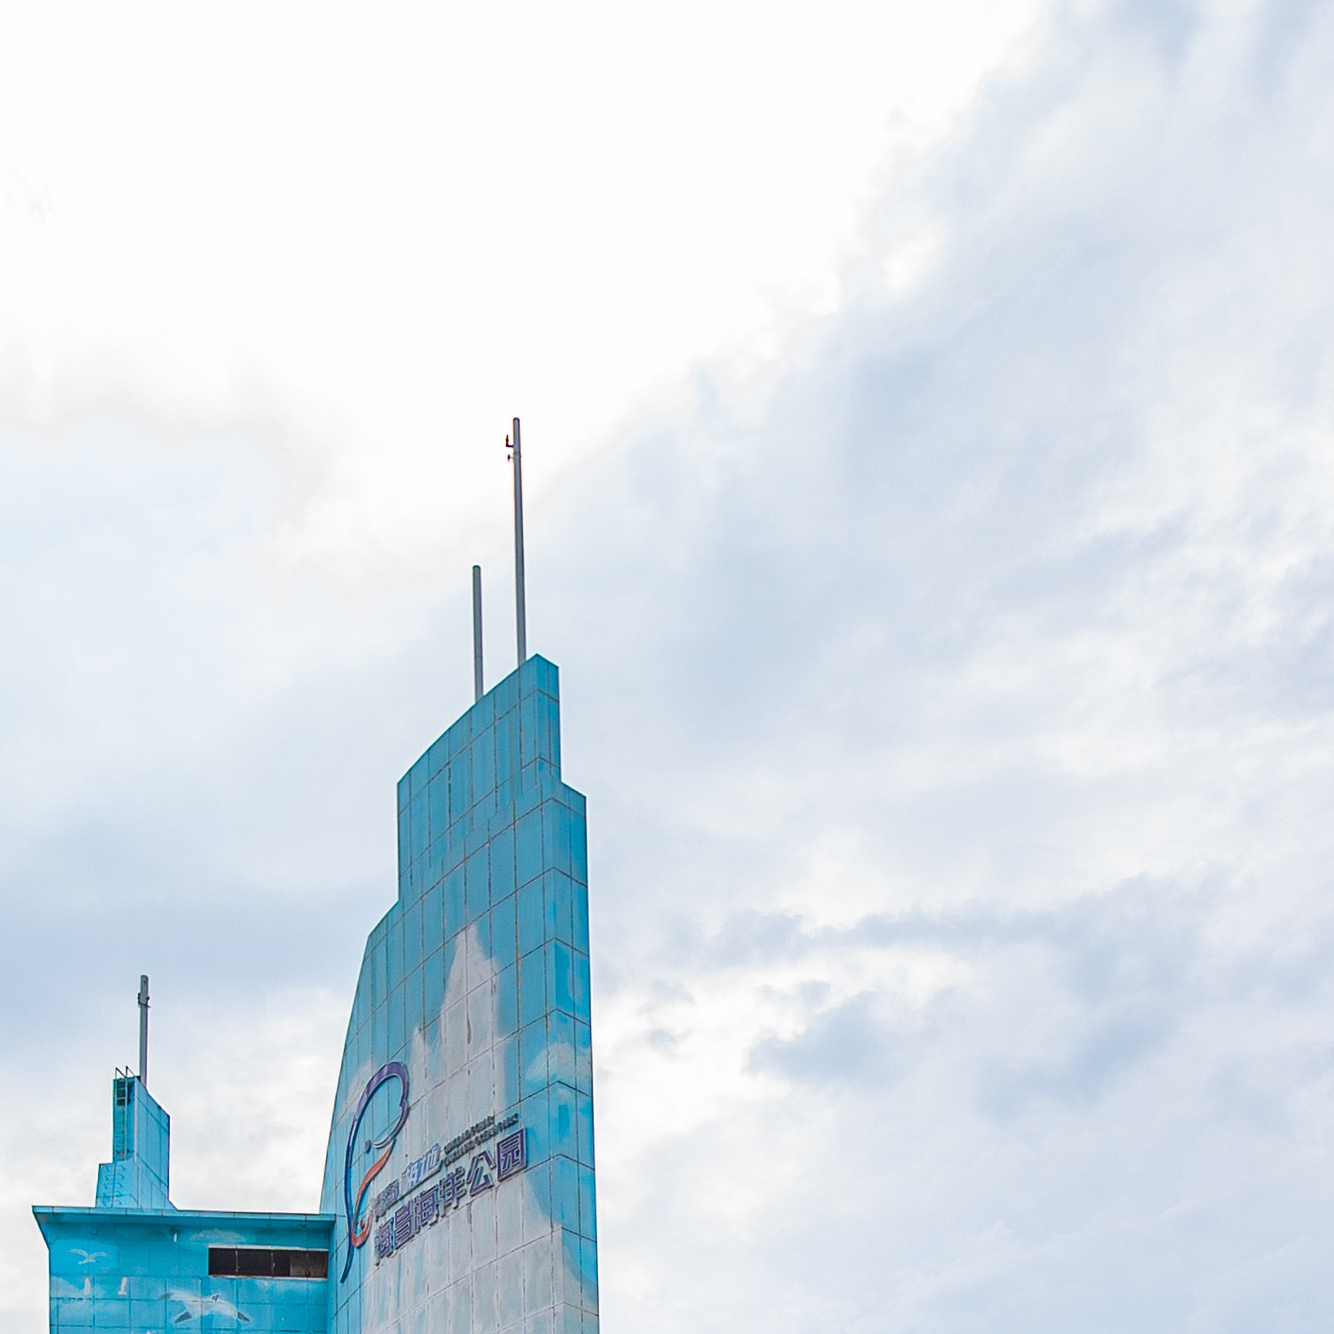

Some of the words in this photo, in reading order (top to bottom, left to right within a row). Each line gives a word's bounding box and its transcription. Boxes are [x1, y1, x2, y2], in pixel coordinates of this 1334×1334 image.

[374, 1127, 527, 1266] 海昌海洋公园
